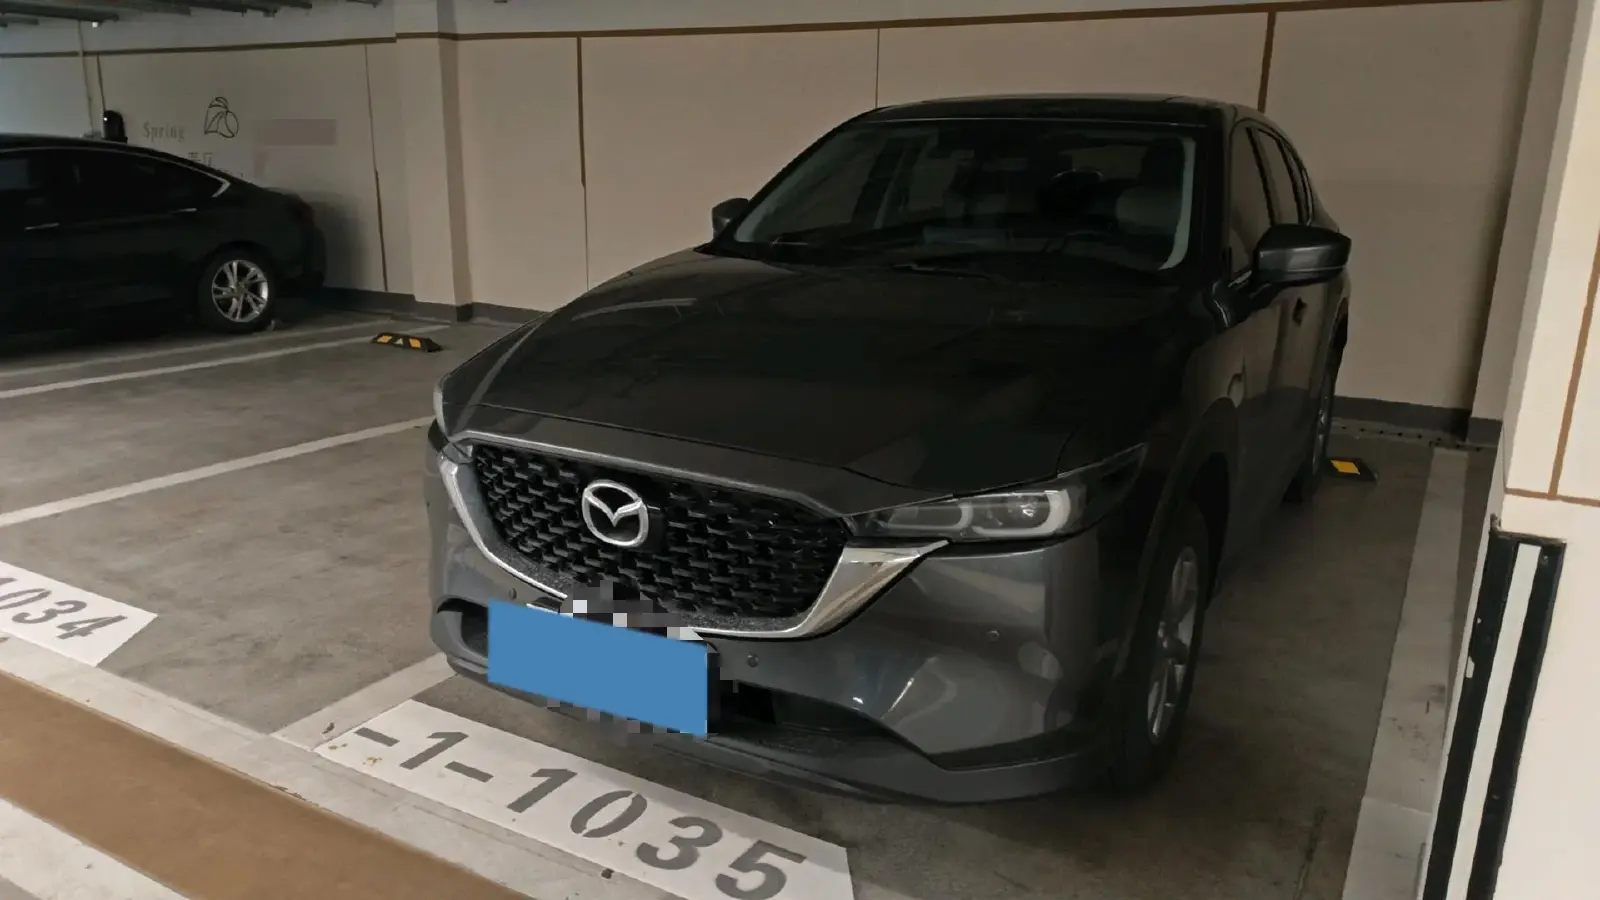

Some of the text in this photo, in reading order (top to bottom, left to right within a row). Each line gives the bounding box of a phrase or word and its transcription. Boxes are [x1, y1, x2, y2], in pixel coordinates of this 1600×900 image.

[143, 121, 186, 142] Spring
[0, 577, 128, 639] 034
[354, 727, 808, 900] -1-1035
